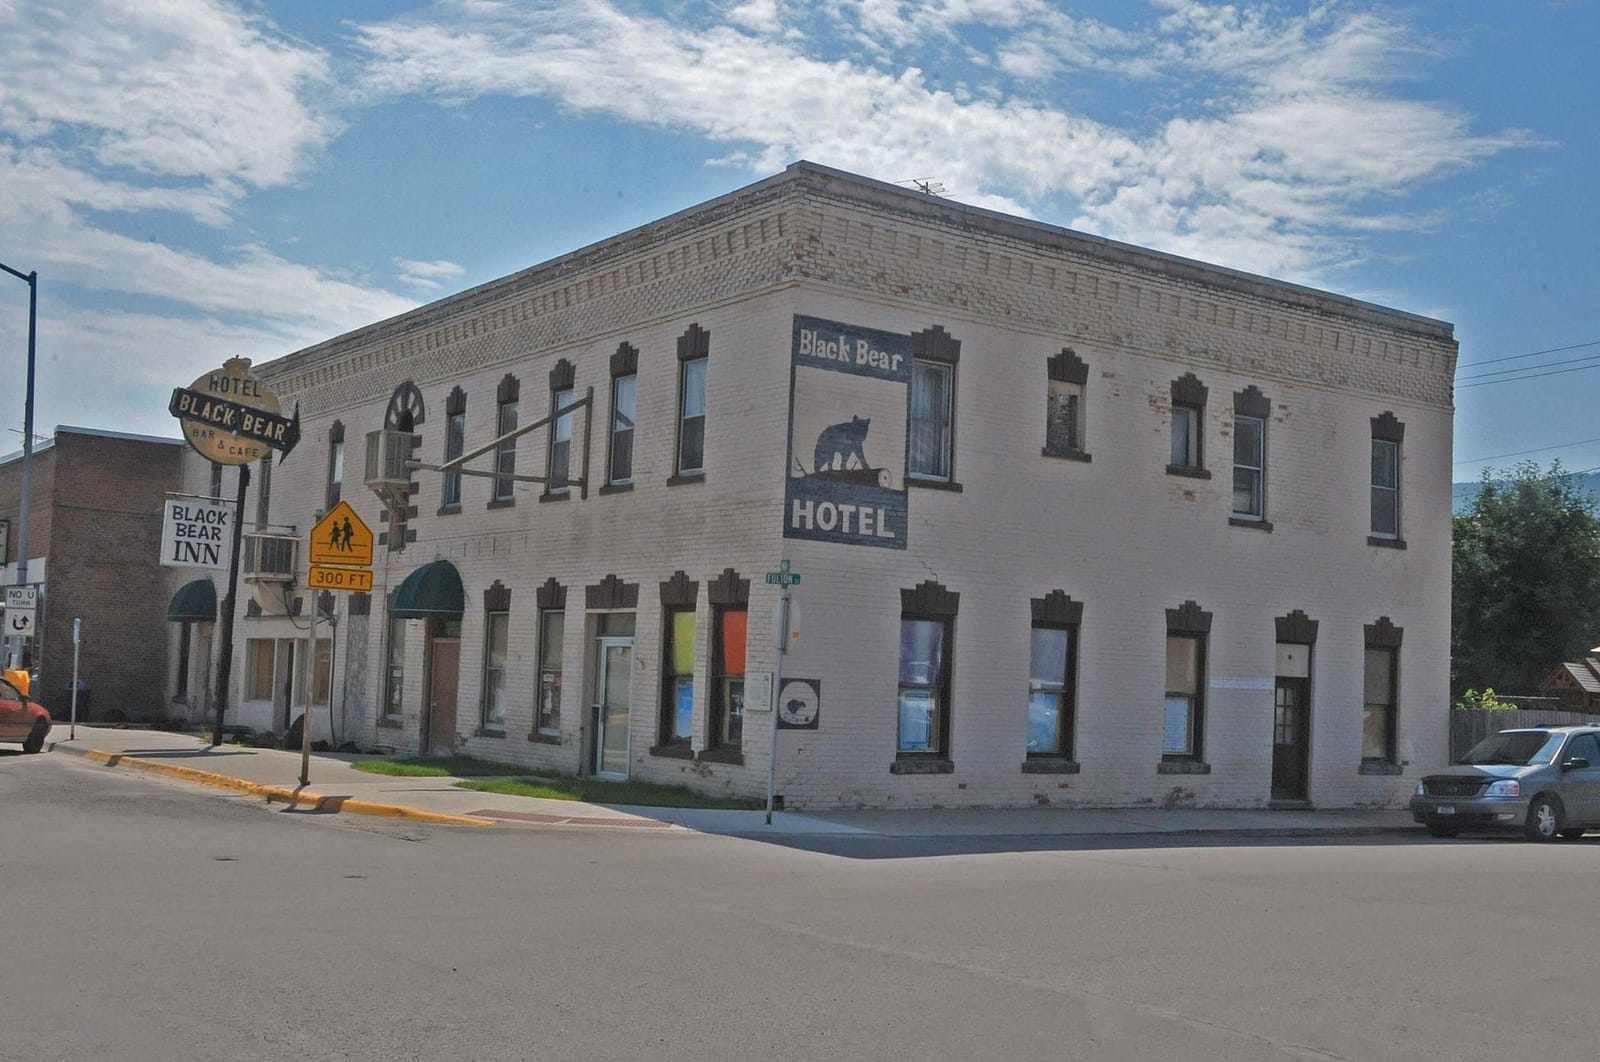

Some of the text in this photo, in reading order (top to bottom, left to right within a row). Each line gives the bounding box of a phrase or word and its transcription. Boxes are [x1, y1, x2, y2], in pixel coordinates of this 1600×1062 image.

[799, 328, 904, 372] Black Bear
[208, 374, 262, 398] HOTEL
[179, 394, 286, 441] BLACK BEAR
[192, 428, 259, 458] BAR & CAFE
[172, 505, 228, 526] BLACK
[792, 499, 895, 538] HOTEL
[175, 522, 222, 541] BEAR
[172, 540, 222, 565] INN
[316, 571, 366, 586] 300 FT
[9, 591, 34, 599] NO U
